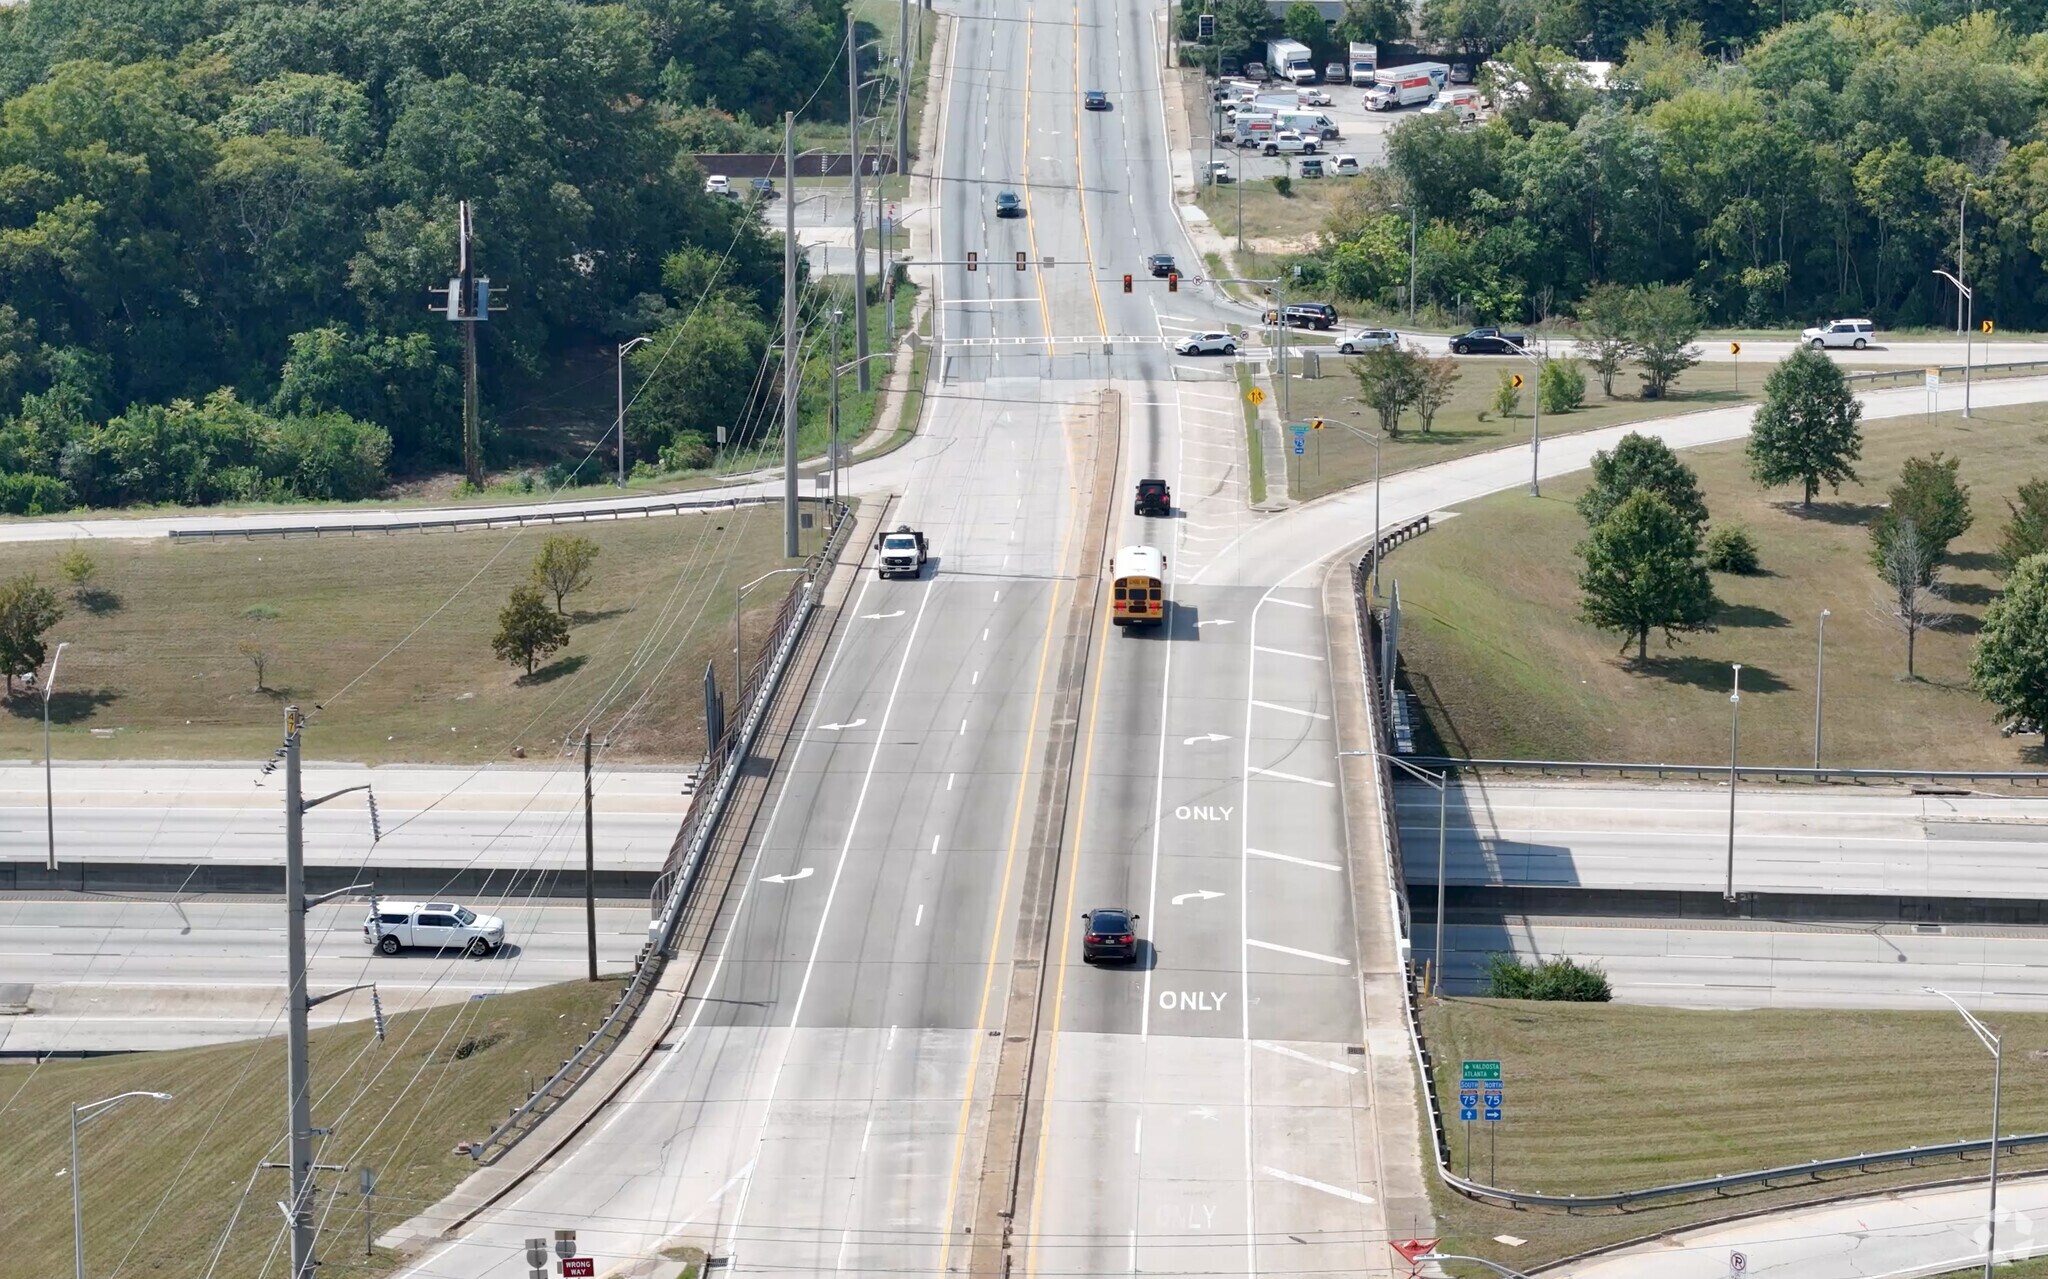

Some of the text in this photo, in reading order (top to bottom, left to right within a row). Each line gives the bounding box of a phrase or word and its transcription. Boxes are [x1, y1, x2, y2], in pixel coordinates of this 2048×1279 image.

[1175, 806, 1234, 821] ONLY
[1159, 990, 1228, 1011] ONLY
[1460, 1081, 1479, 1089] SOUTH
[1484, 1081, 1503, 1089] NORTH
[1462, 1095, 1476, 1105] 75
[1486, 1095, 1500, 1105] 75
